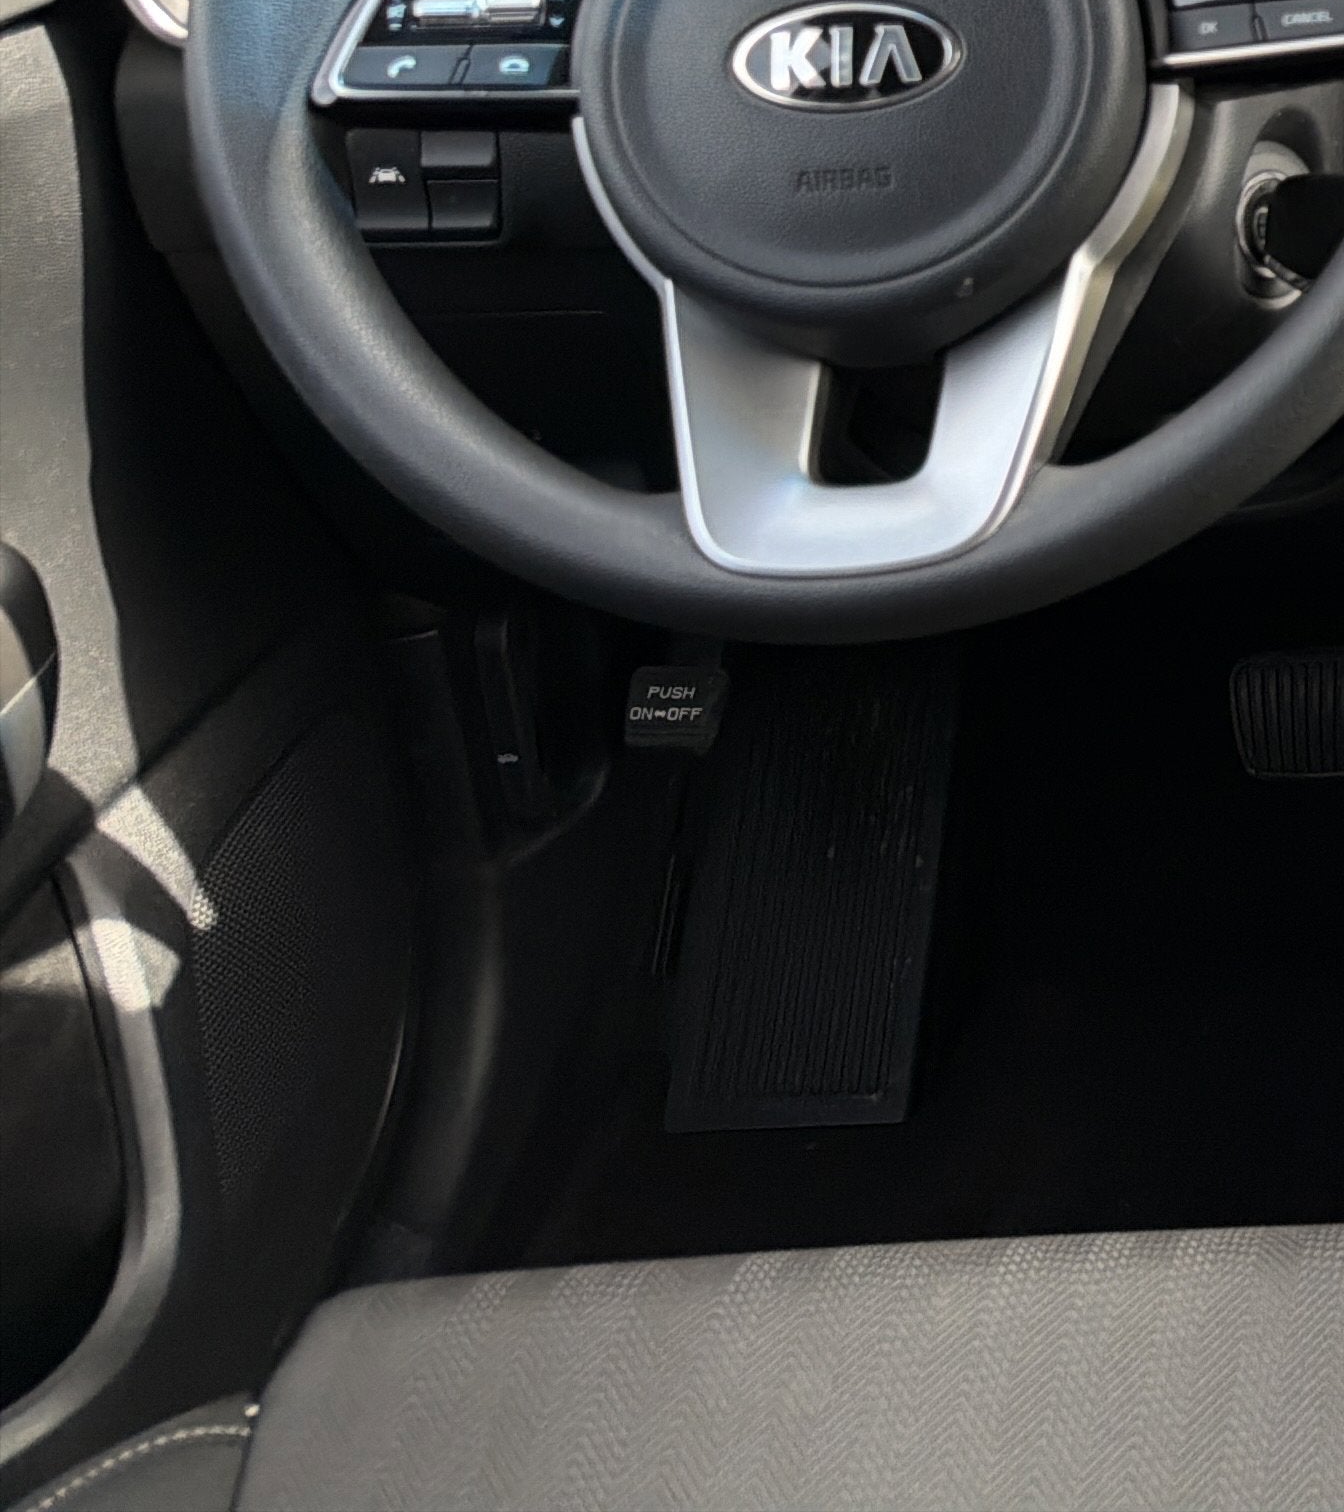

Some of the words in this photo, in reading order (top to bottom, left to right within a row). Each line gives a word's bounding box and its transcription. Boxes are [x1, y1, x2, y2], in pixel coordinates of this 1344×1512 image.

[1280, 10, 1334, 28] CANCEL
[1198, 21, 1219, 35] OK
[769, 24, 924, 90] KIA
[797, 164, 896, 192] AIRBAG
[646, 685, 697, 700] PUSH
[629, 705, 655, 721] ON
[666, 706, 704, 721] OFF
